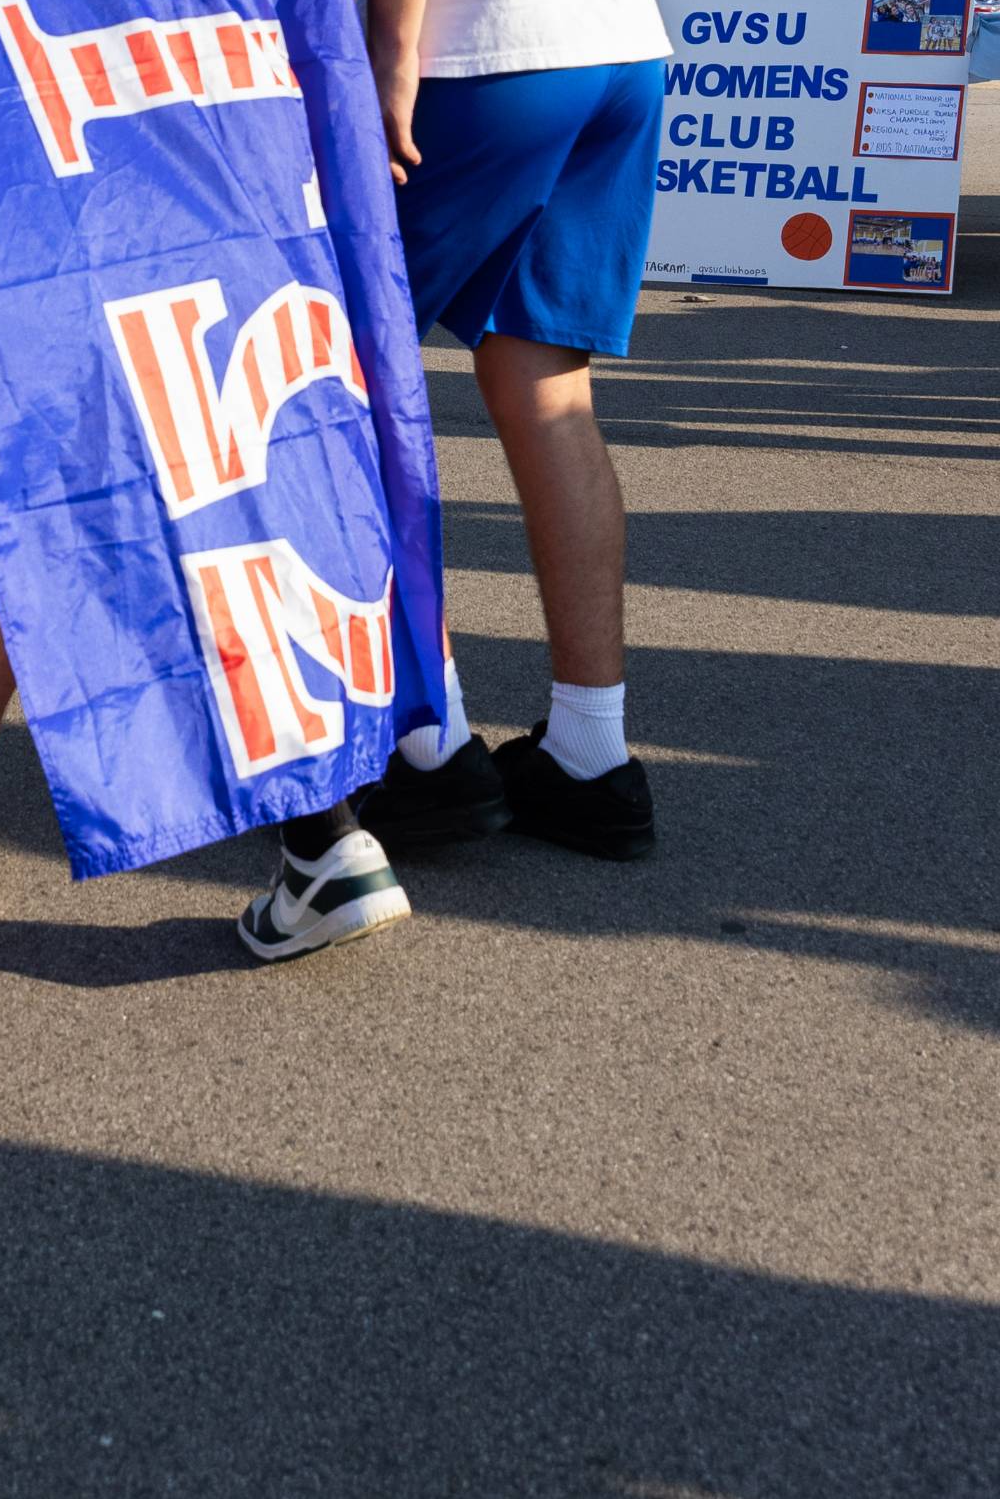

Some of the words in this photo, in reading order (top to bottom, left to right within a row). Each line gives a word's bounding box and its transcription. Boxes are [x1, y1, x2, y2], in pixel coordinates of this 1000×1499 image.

[681, 10, 807, 45] GVSU
[664, 63, 849, 101] WOMENS
[669, 113, 795, 150] CLUB
[871, 125, 909, 135] REGIONAL
[656, 159, 878, 202] SKETBALL
[645, 261, 690, 274] TAGRAM:
